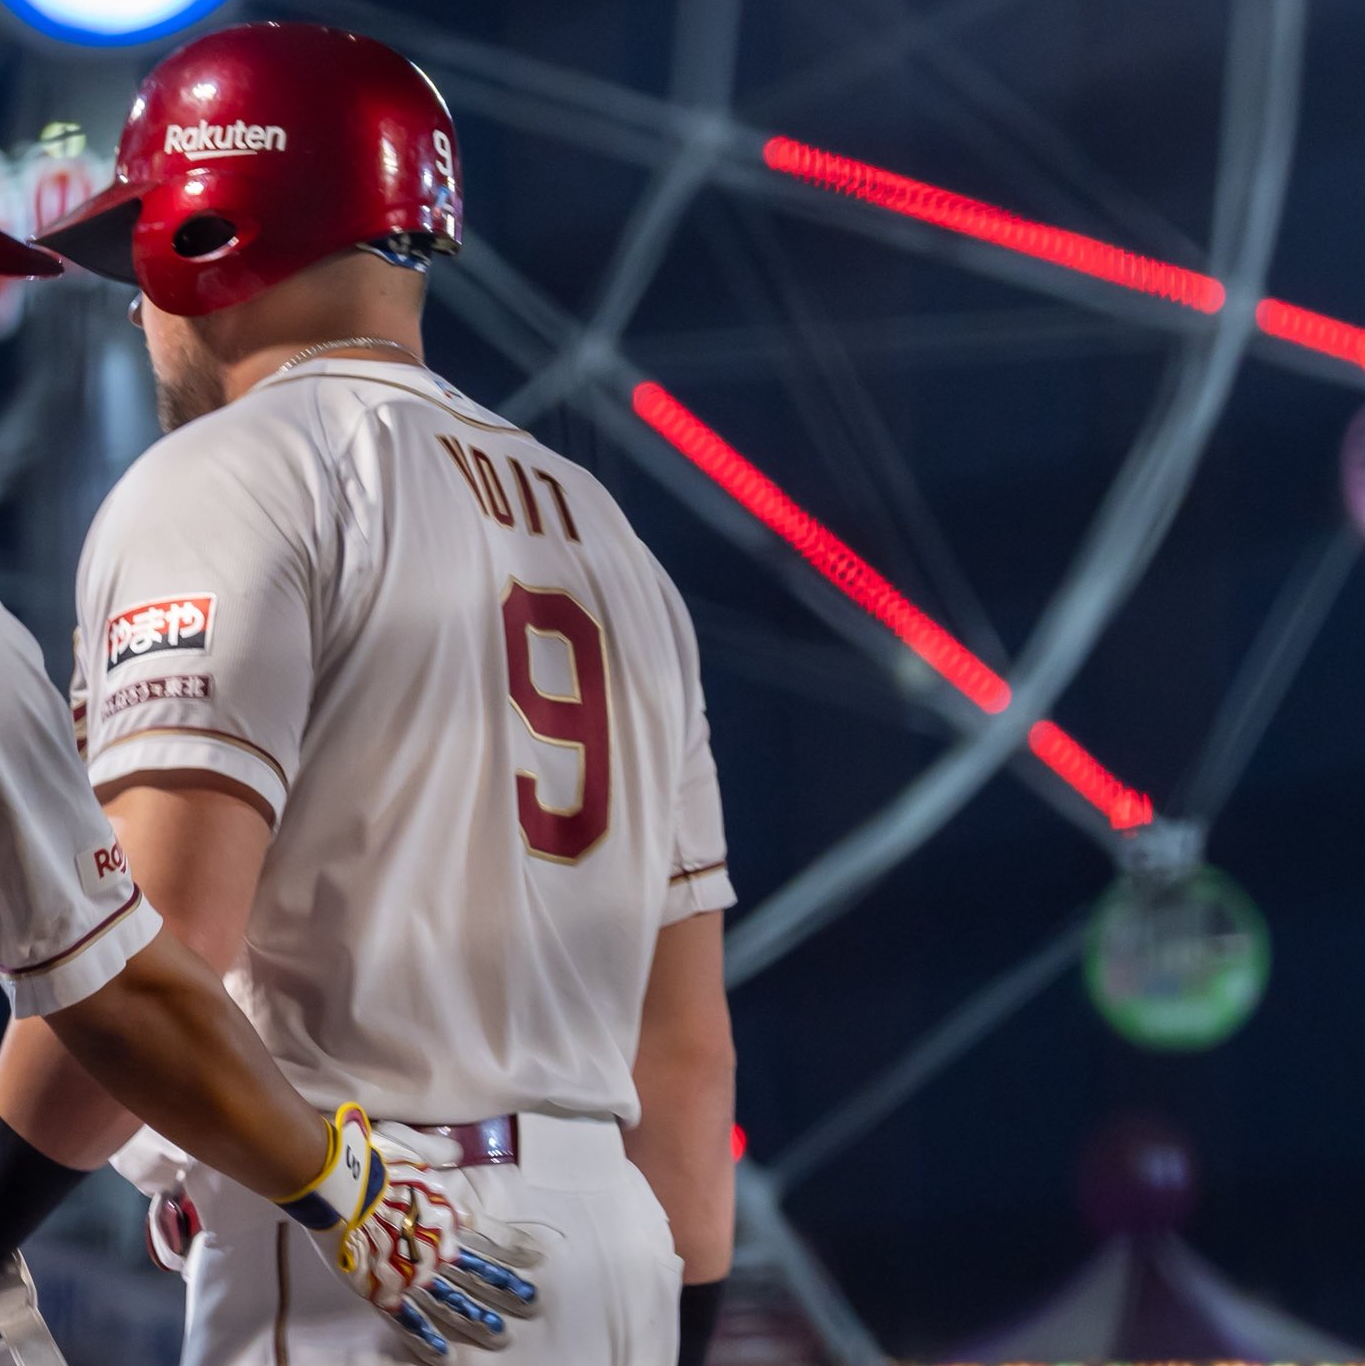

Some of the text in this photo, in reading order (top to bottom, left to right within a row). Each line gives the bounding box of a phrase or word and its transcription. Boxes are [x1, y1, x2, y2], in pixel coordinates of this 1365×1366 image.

[163, 119, 287, 157] Rakuten
[432, 128, 454, 177] 9
[109, 601, 206, 665] やまや
[500, 574, 610, 867] 9
[93, 841, 127, 880] Ra
